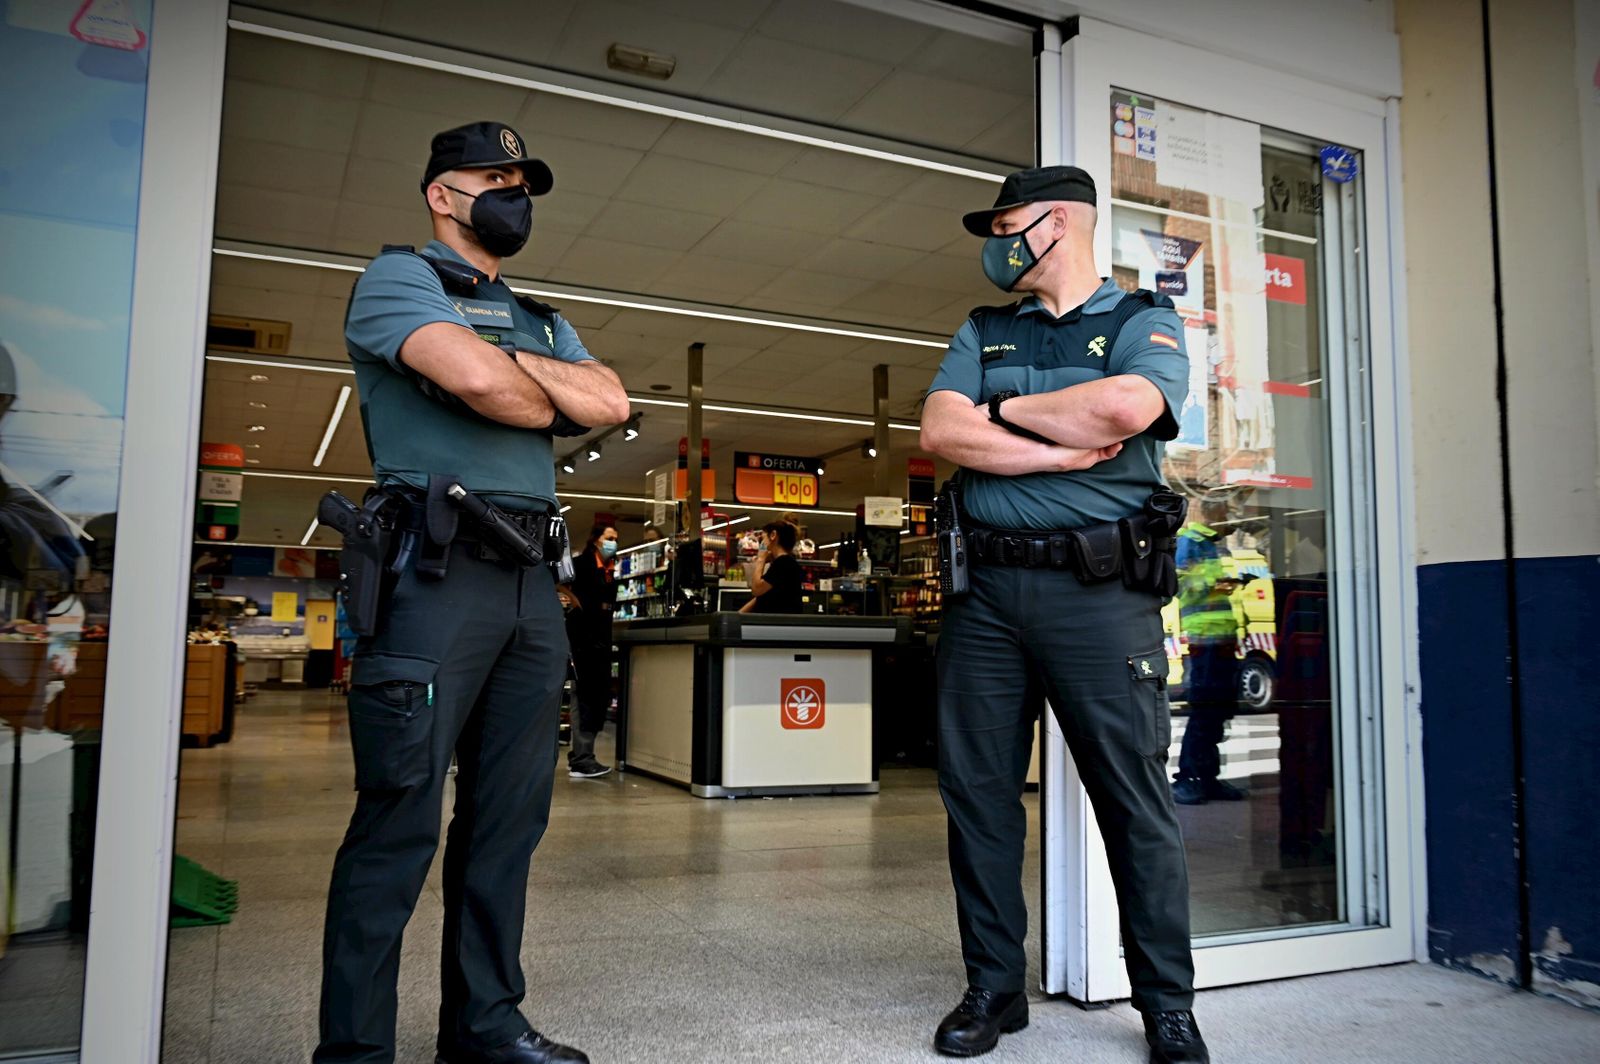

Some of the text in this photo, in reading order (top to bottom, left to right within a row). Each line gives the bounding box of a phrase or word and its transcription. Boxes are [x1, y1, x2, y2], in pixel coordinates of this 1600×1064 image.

[465, 306, 493, 315] GUARDIA
[202, 452, 241, 460] OFERTA
[763, 457, 806, 470] OFERTA
